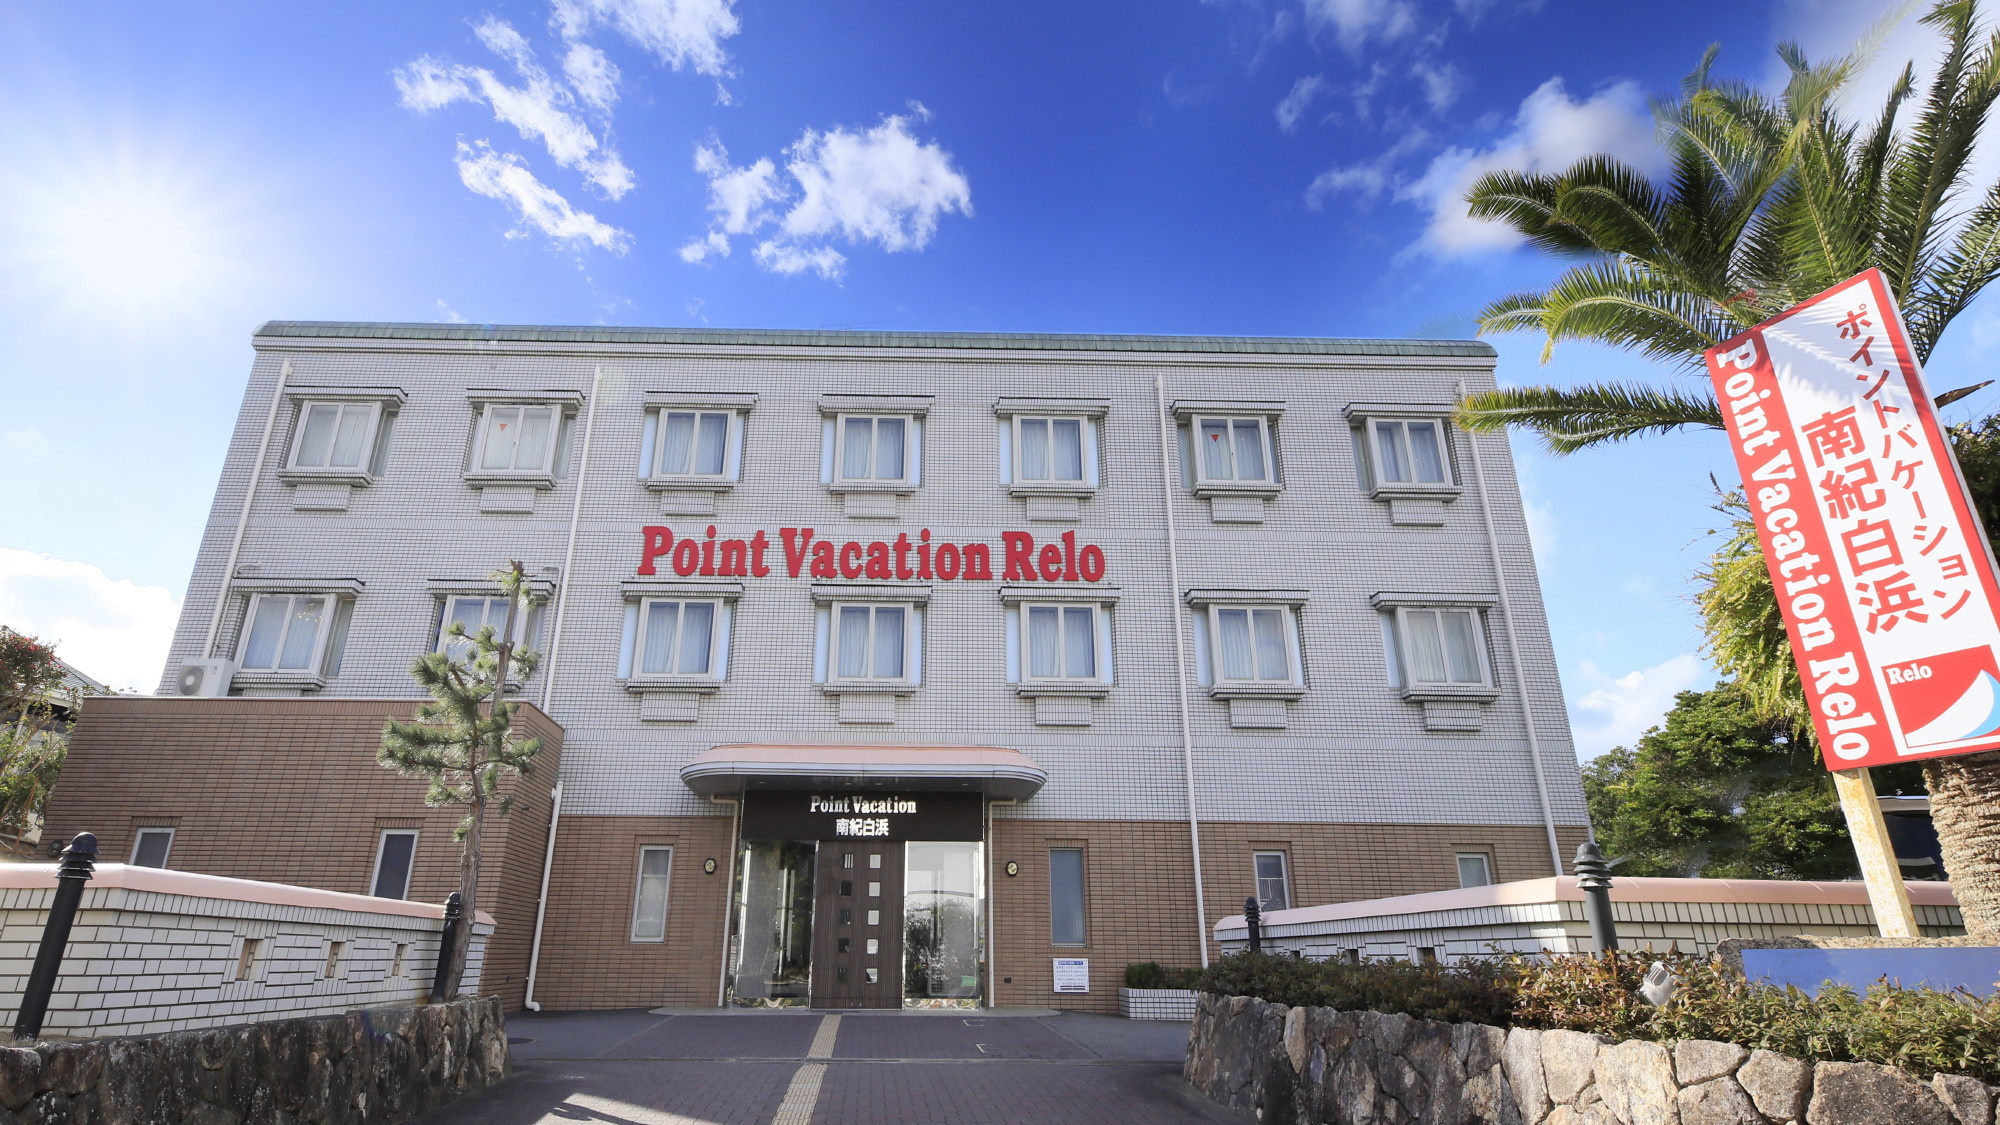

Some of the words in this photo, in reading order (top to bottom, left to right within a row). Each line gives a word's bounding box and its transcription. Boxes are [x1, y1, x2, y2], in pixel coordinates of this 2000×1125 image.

[1836, 303, 1971, 620] ポイントバケーション
[1801, 405, 1928, 635] 南紀白浜
[638, 525, 770, 577] Point
[780, 527, 992, 580] Vacation
[1002, 530, 1105, 581] Relo
[1715, 338, 1769, 456] Point
[1752, 449, 1835, 650] Vacation
[1810, 652, 1877, 761] Relo
[1886, 664, 1932, 684] Relo
[810, 795, 850, 813] Point
[852, 795, 917, 814] Vacation
[836, 818, 889, 836] 南紀白浜
